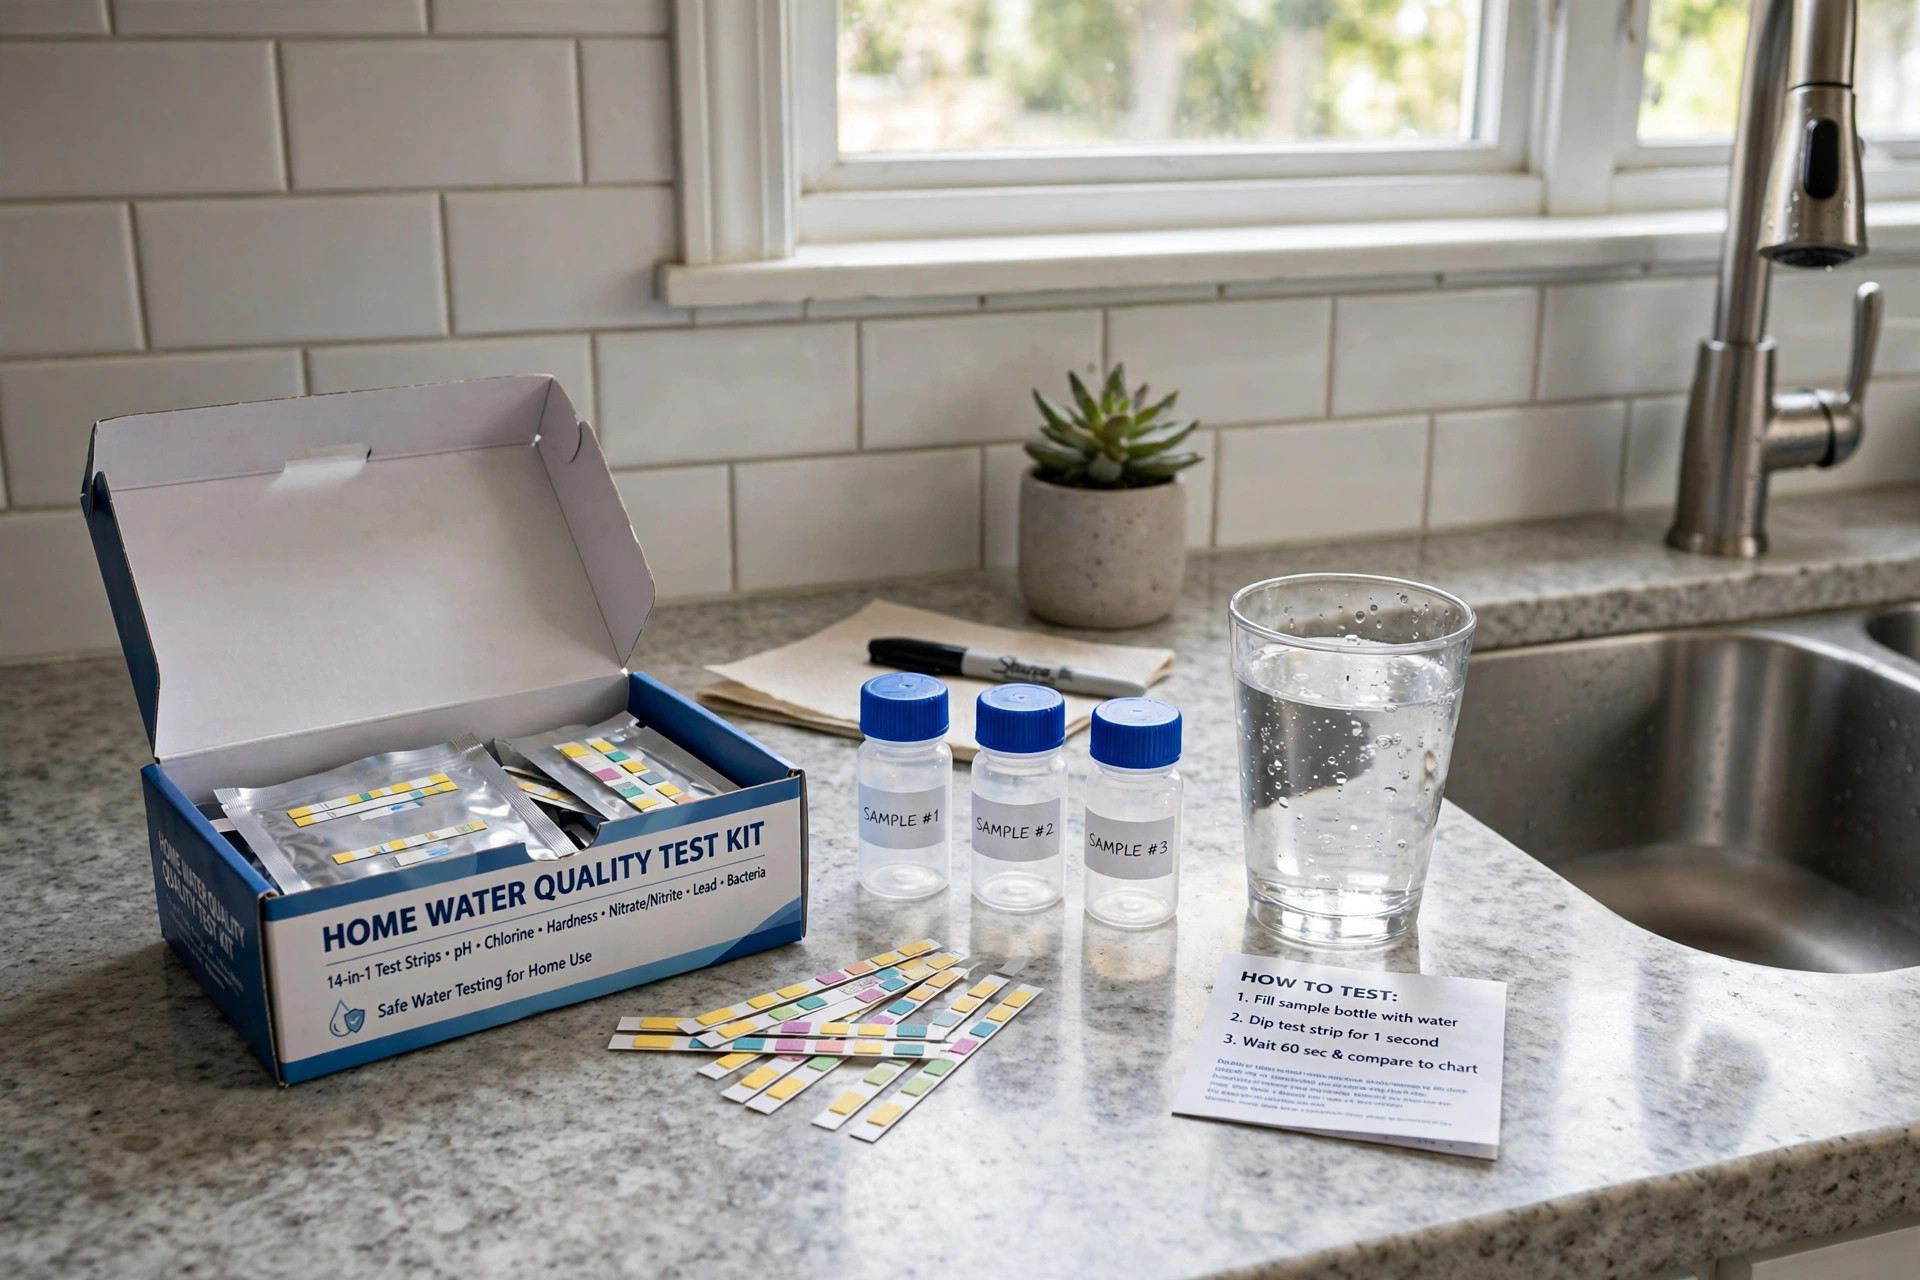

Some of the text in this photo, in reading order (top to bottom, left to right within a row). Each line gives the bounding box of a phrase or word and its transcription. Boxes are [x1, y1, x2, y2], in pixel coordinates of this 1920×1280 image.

[863, 806, 939, 827] SAMPLE #1
[976, 816, 1055, 839] SAMPLE #2
[1089, 832, 1168, 857] SAMPLE #3
[322, 820, 765, 953] HOME WATER QUALITY TEST KIT
[327, 866, 766, 990] 14-in-1 Test Strips pH Chlorine Hardness Nitrate/Nitrite Lead Bacteria
[377, 952, 593, 1019] Safe Water Testing for Home Use
[1240, 970, 1398, 1002] HOW TO TEST:
[1237, 992, 1458, 1027] 1. Fill sample bottle with water
[1229, 1012, 1439, 1048] 2. Dip test strip for 1 second
[1222, 1033, 1478, 1074] 3. Wait 60 sec & compare to chart
